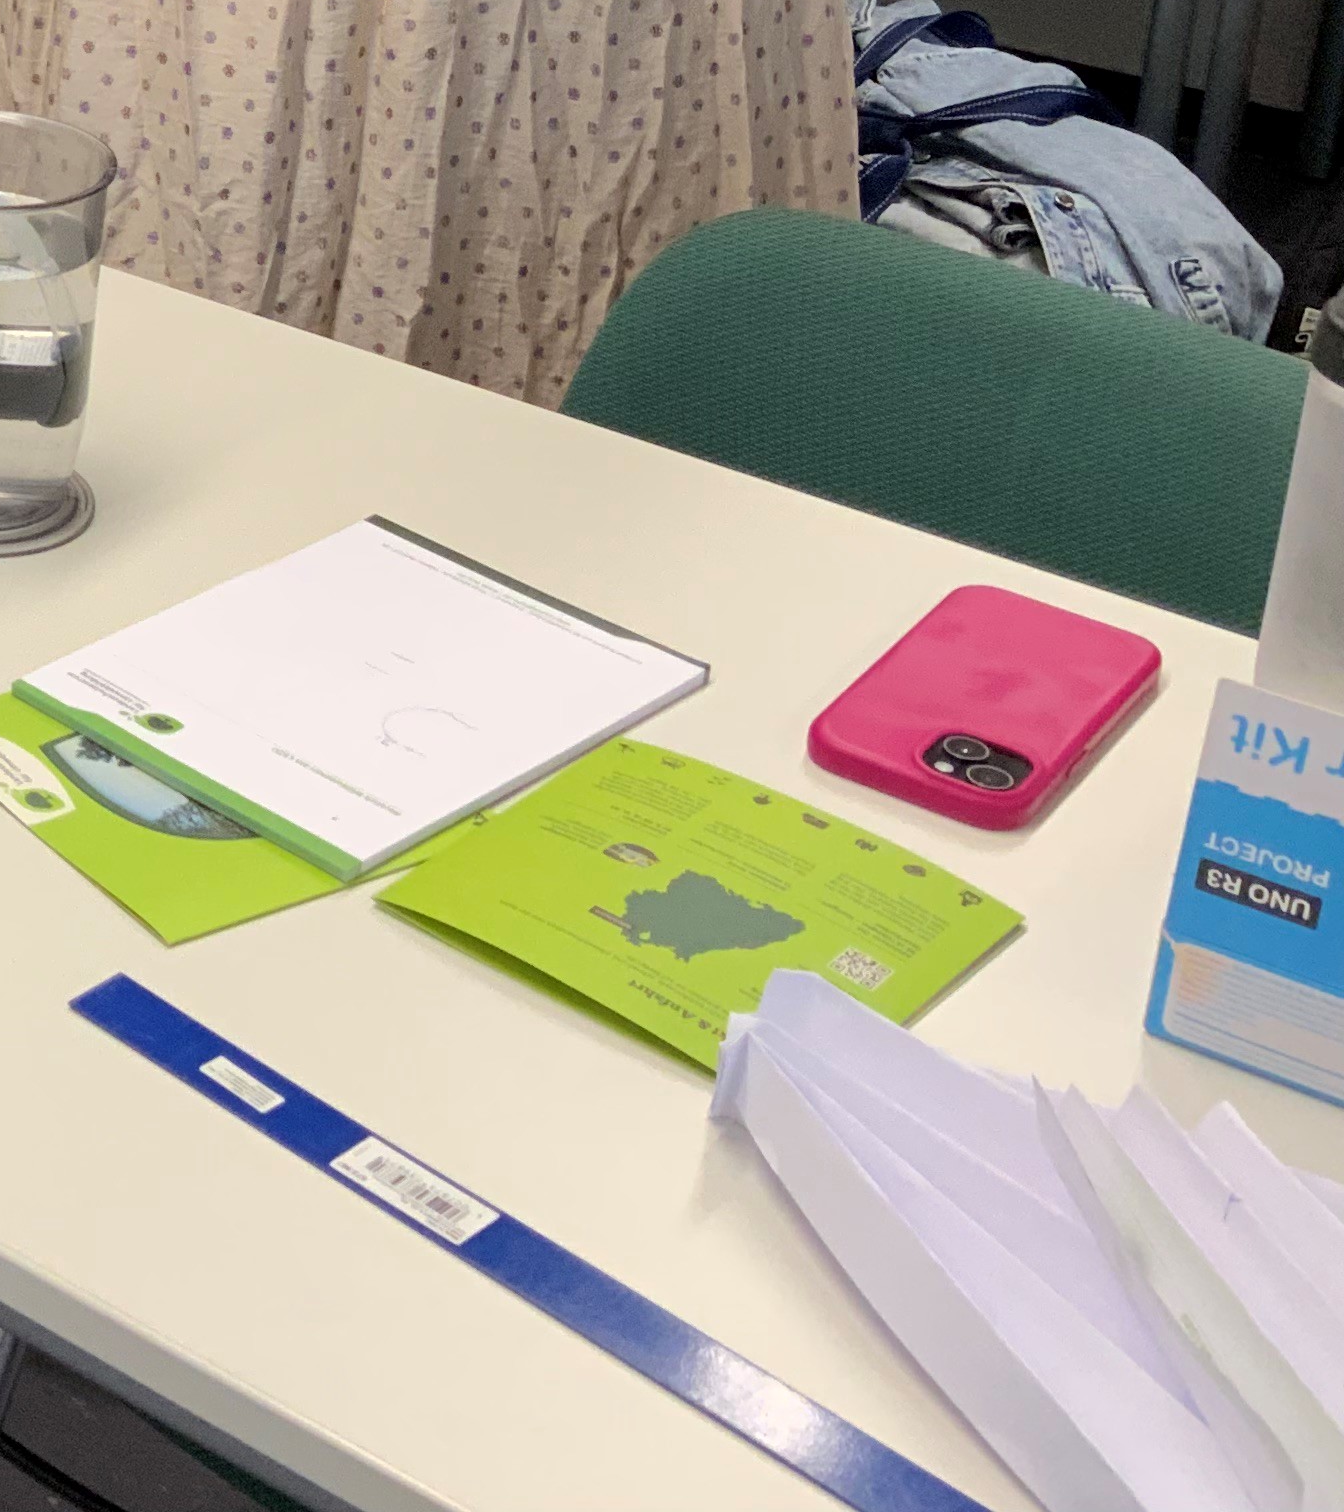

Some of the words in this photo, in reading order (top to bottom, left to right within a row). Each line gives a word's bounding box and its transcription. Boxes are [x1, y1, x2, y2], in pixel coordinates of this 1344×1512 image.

[1230, 713, 1310, 775] Kit
[1202, 831, 1332, 889] PROJECT
[1205, 868, 1243, 896] R3
[1247, 883, 1312, 922] UNO
